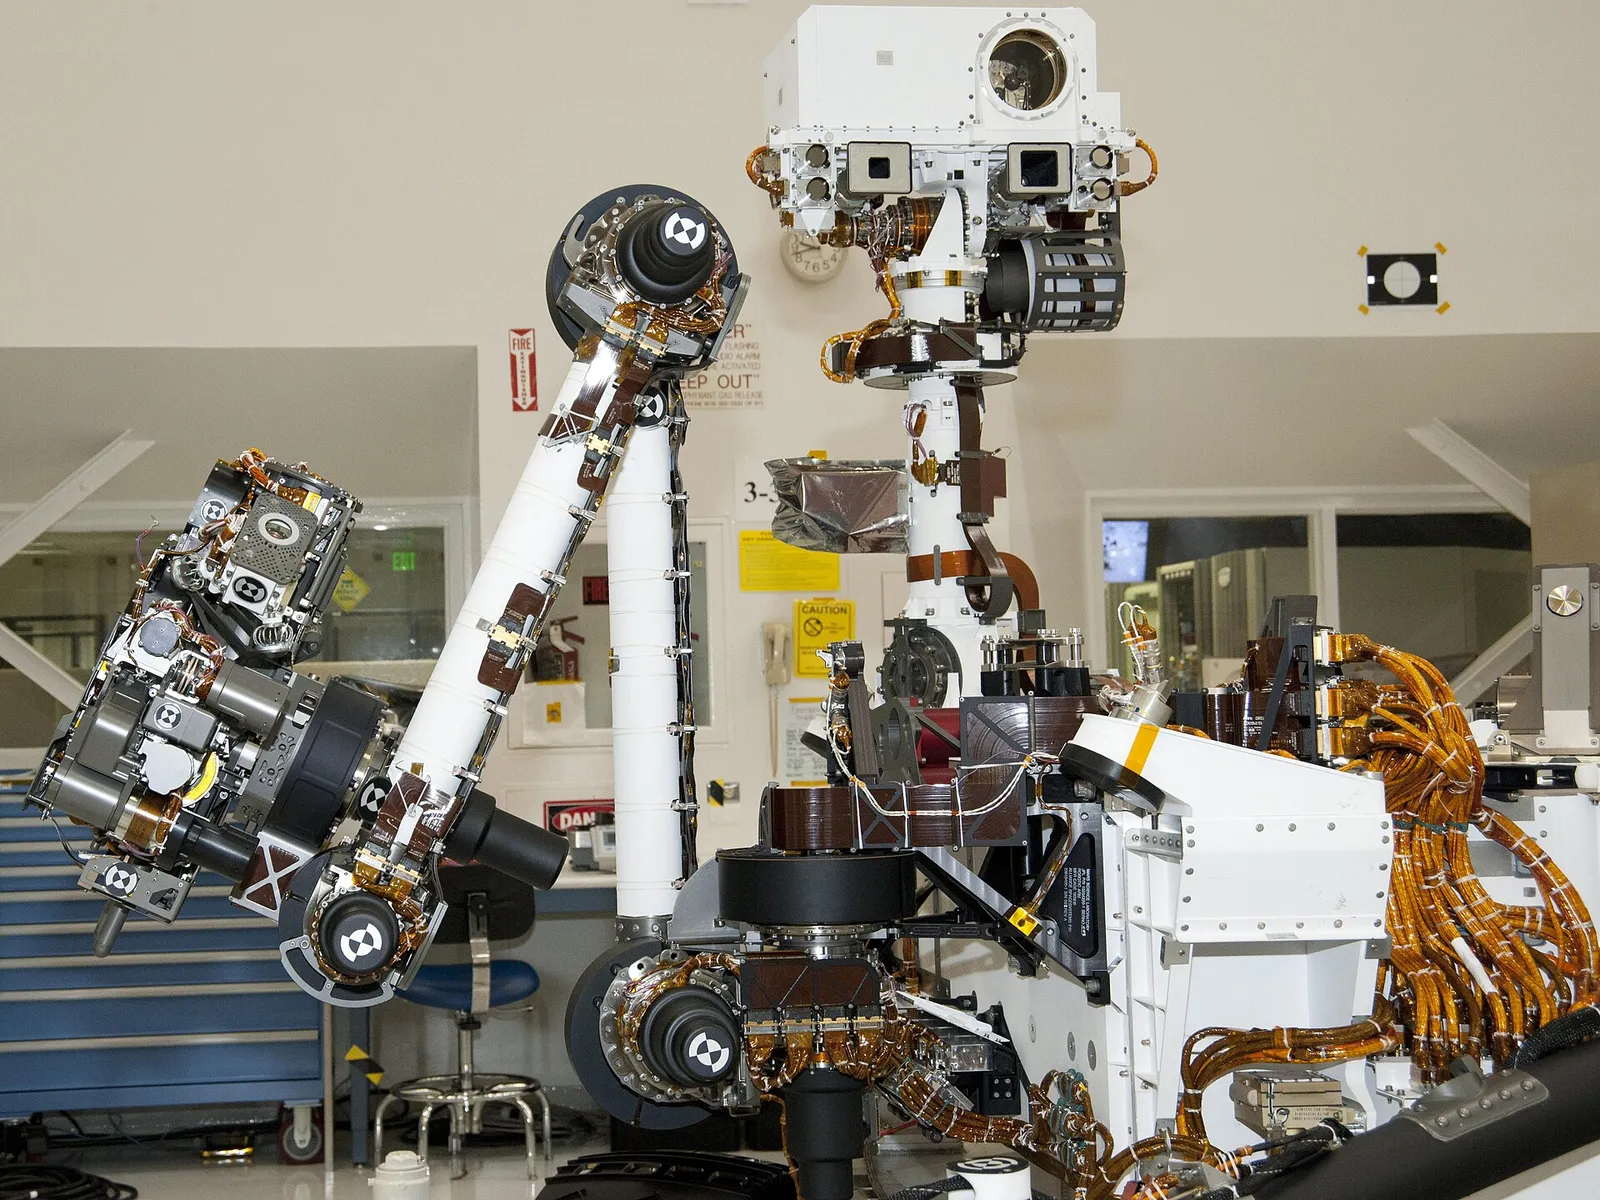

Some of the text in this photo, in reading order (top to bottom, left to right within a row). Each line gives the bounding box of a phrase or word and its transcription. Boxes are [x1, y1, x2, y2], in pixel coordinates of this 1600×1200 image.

[795, 252, 803, 263] 8
[830, 252, 838, 262] 4
[803, 260, 811, 270] 7
[812, 262, 820, 273] 6
[822, 259, 830, 270] 5
[725, 324, 752, 339] R"
[512, 337, 532, 350] FIRE
[724, 341, 759, 351] FLASHING
[736, 352, 760, 361] ALARM
[721, 362, 761, 371] ACTIVATED
[801, 605, 848, 615] CAUTION
